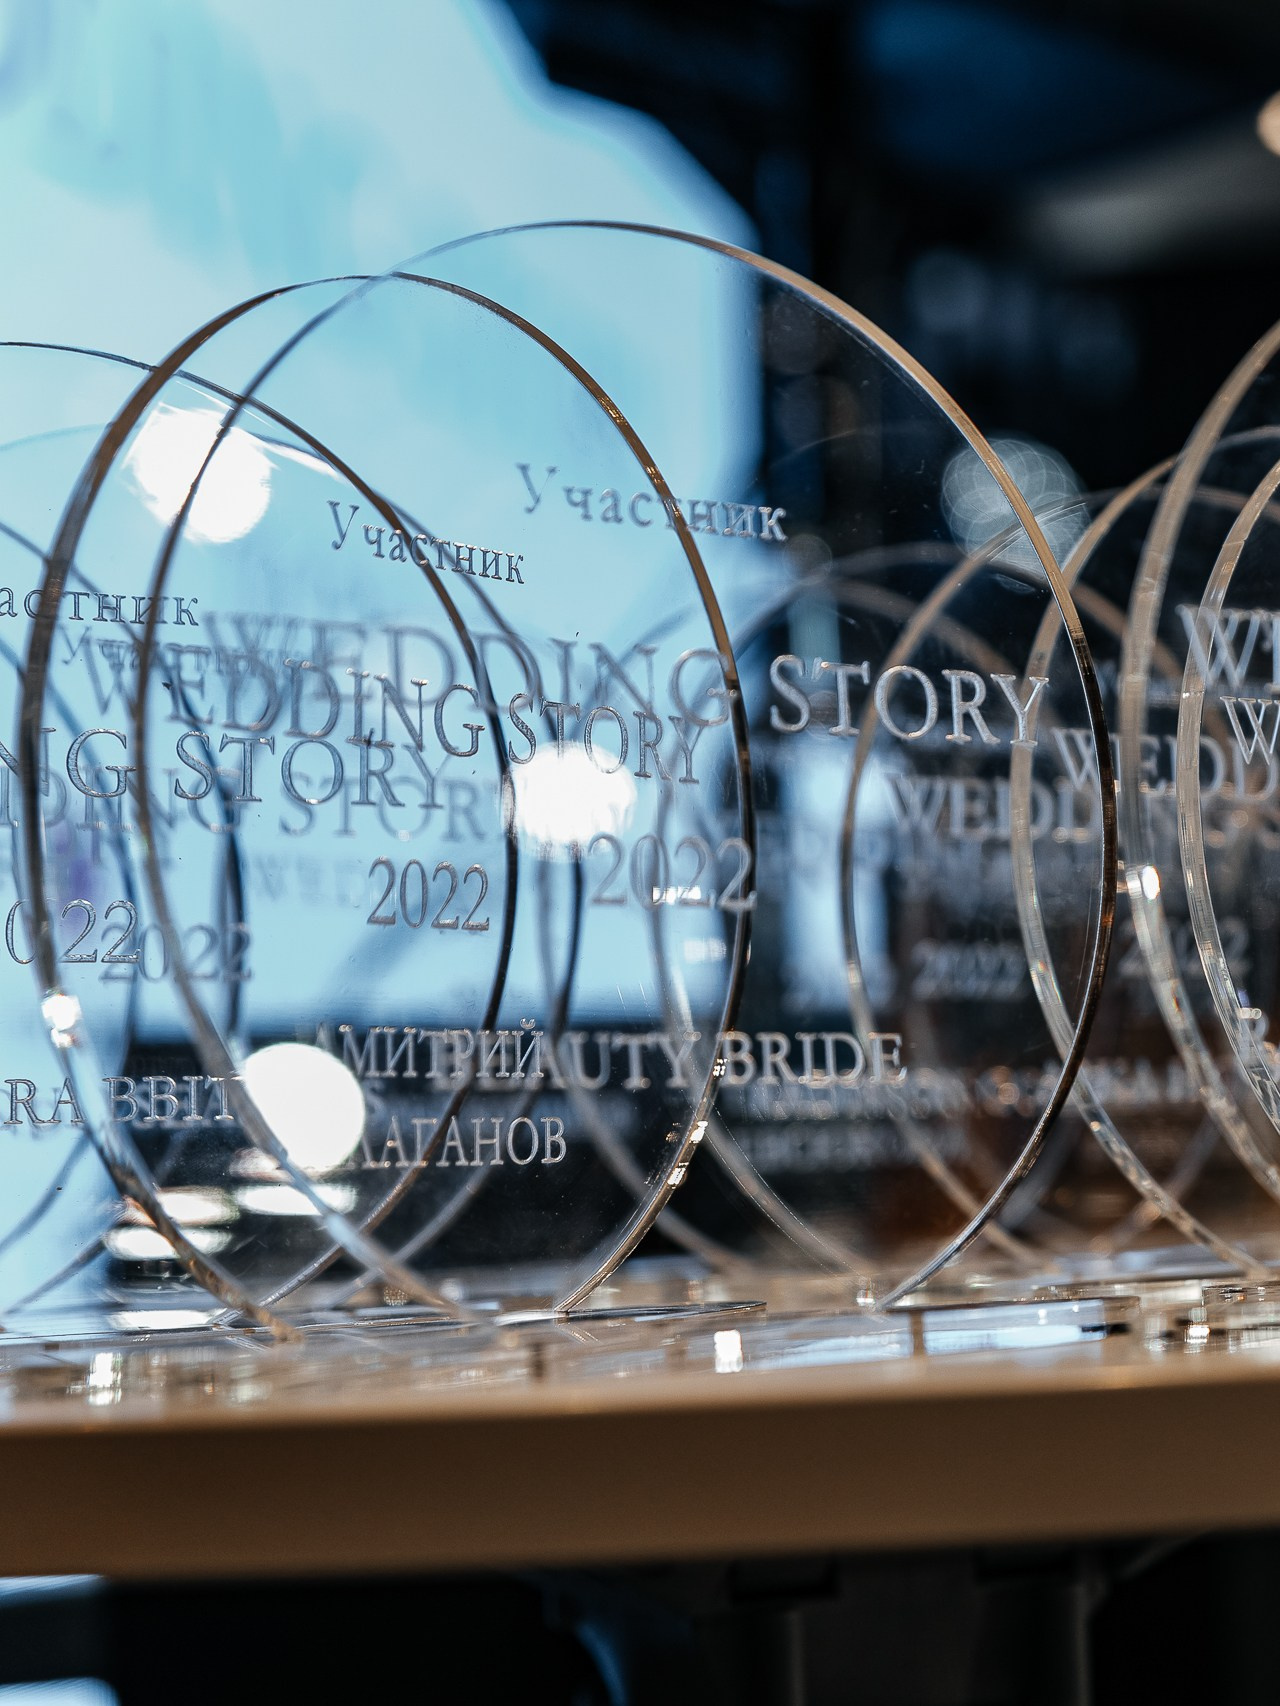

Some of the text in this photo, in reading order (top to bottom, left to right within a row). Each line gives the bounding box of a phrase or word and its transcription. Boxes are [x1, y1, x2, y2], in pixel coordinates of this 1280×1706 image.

[328, 500, 525, 585] Участник
[203, 611, 737, 728] WEDDING
[769, 654, 1051, 746] STORY
[174, 729, 459, 809] STORY
[508, 692, 703, 785] STORY
[278, 773, 506, 844] STOR
[366, 855, 491, 932] 2022
[586, 831, 758, 912] 2022
[717, 1030, 908, 1087] BRIDE
